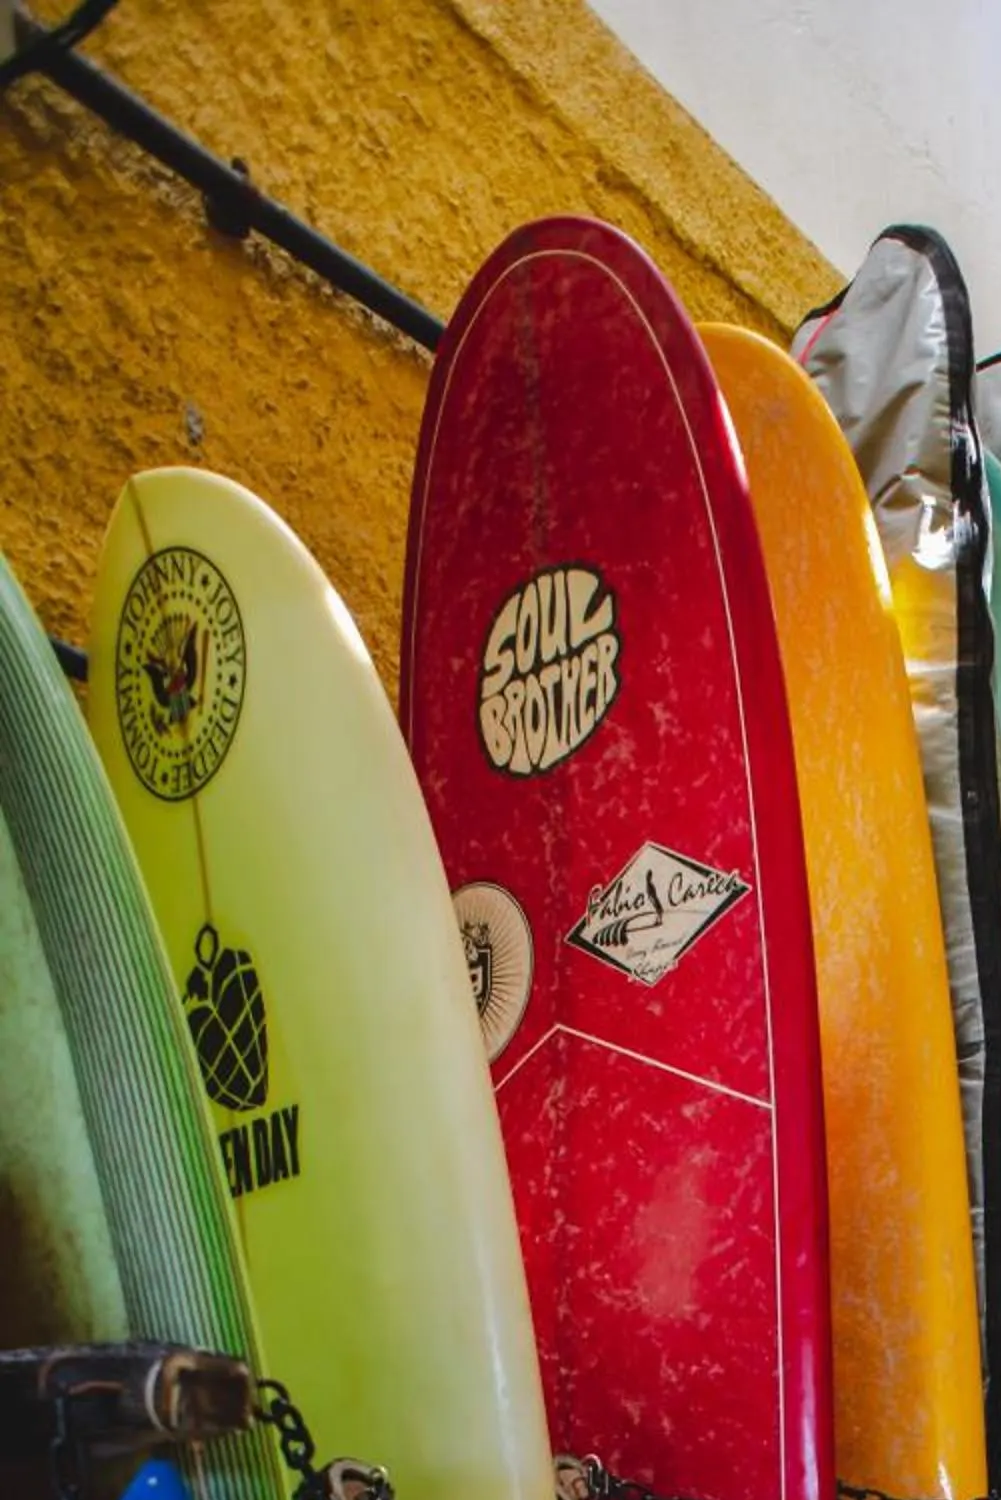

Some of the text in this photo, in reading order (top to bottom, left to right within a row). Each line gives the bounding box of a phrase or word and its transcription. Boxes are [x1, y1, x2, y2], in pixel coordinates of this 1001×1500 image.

[126, 553, 200, 636] JOHNNY
[206, 580, 244, 668] JOEY
[481, 568, 614, 699] SOUL
[117, 662, 159, 786] TOMMY
[479, 633, 620, 775] BROTHER
